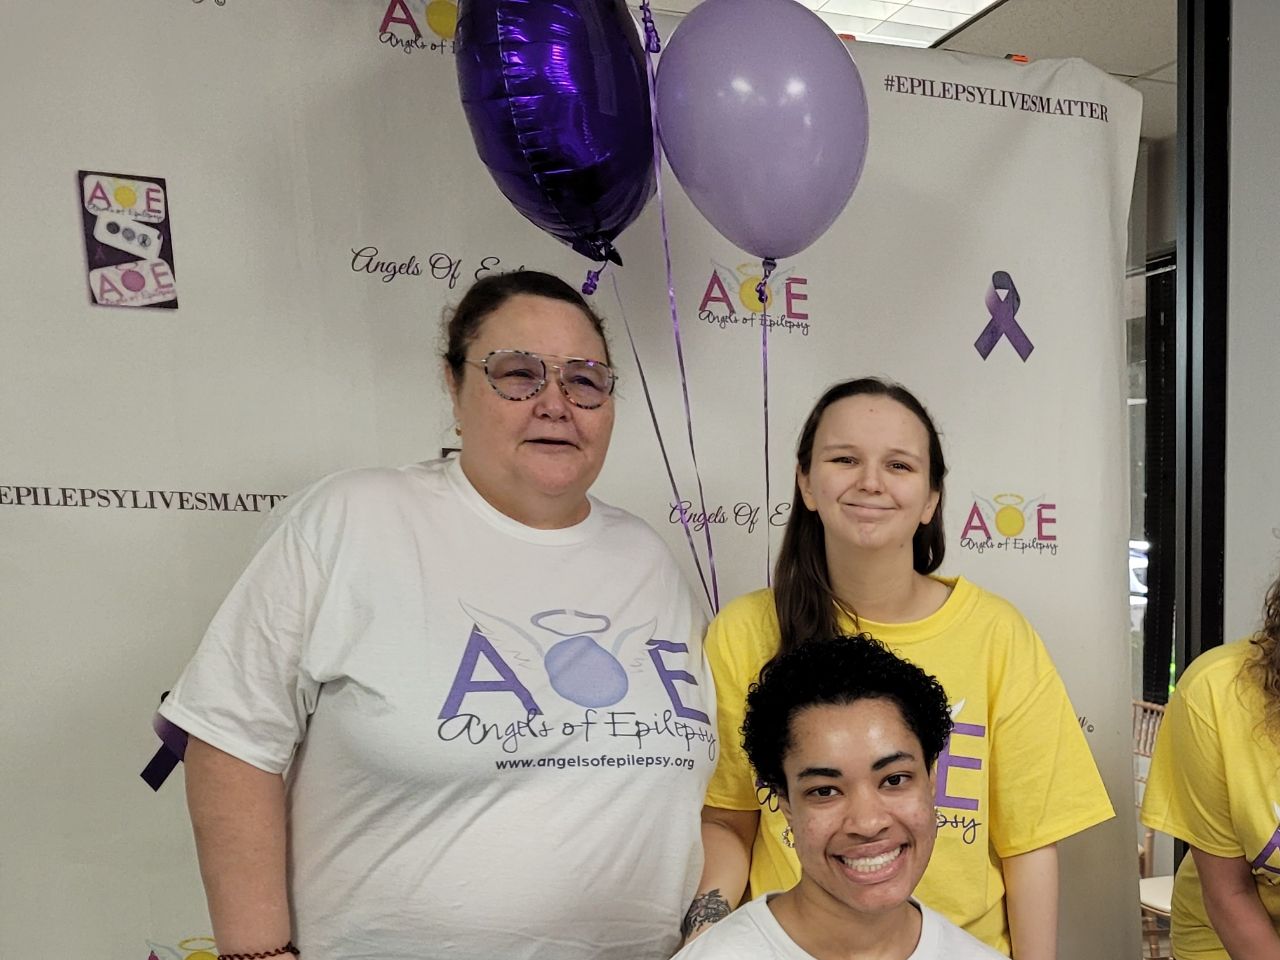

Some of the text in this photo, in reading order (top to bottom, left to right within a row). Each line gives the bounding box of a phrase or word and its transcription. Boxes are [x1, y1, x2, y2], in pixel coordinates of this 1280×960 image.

[379, 31, 449, 55] Angels of
[884, 74, 1109, 123] #EPILEPSYLIVESMATTER
[351, 246, 462, 289] Angels Of
[698, 308, 810, 335] Angels of Epilepsy
[0, 485, 288, 513] EPILEPSYLIVESMATT
[669, 501, 759, 534] Angels Of
[960, 536, 1058, 556] Angels of Epilepsy
[438, 706, 716, 761] Angels of Epilepsy
[495, 754, 695, 770] www.angelsofepilepsy.org
